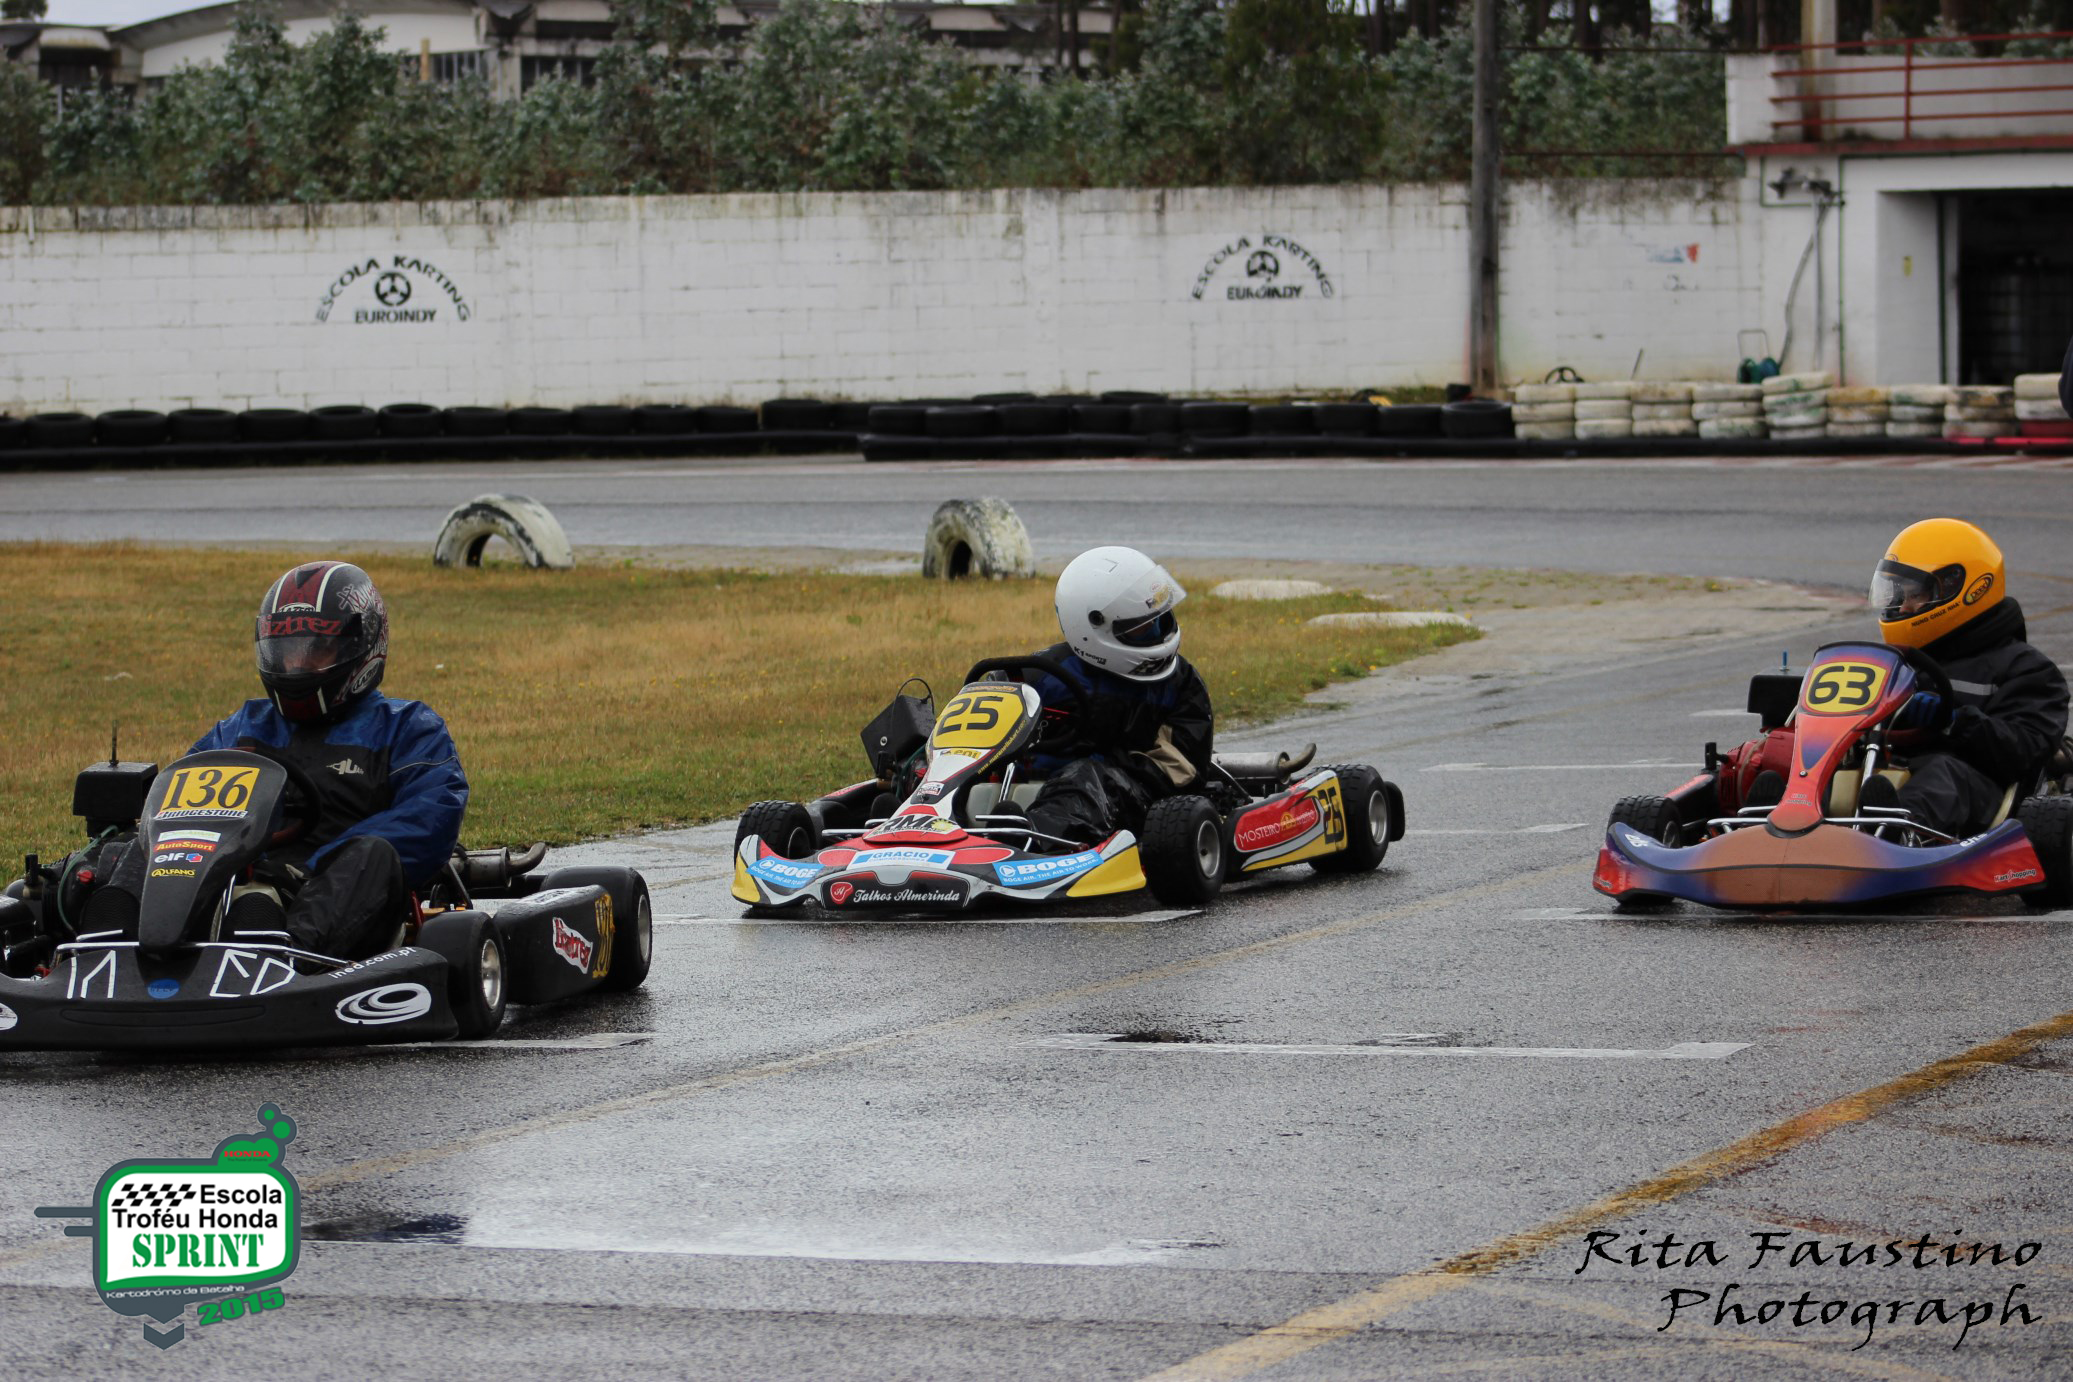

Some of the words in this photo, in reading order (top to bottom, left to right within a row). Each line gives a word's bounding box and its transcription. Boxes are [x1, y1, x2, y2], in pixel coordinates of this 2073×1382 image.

[1192, 237, 1250, 299] ESCOLA
[1262, 235, 1334, 298] KARTING
[315, 258, 380, 323] ESCOLA
[394, 255, 471, 322] KARTING
[355, 309, 437, 324] EUROINDY
[1809, 665, 1876, 706] 63
[936, 695, 1004, 737] 25
[163, 769, 253, 811] 136
[154, 809, 249, 819] BRIDGESTONE
[1317, 786, 1345, 845] 25
[156, 841, 213, 851] AutoSport
[1237, 822, 1280, 848] MOSTEIRO
[154, 852, 185, 863] elf
[873, 851, 930, 859] GRACIO
[1017, 853, 1095, 875] BOGE
[151, 868, 195, 878] ALFANO
[770, 864, 819, 878] BOGE
[853, 889, 892, 903] Talhos
[894, 888, 962, 902] Almerinda
[328, 946, 416, 979] ined.com.pt
